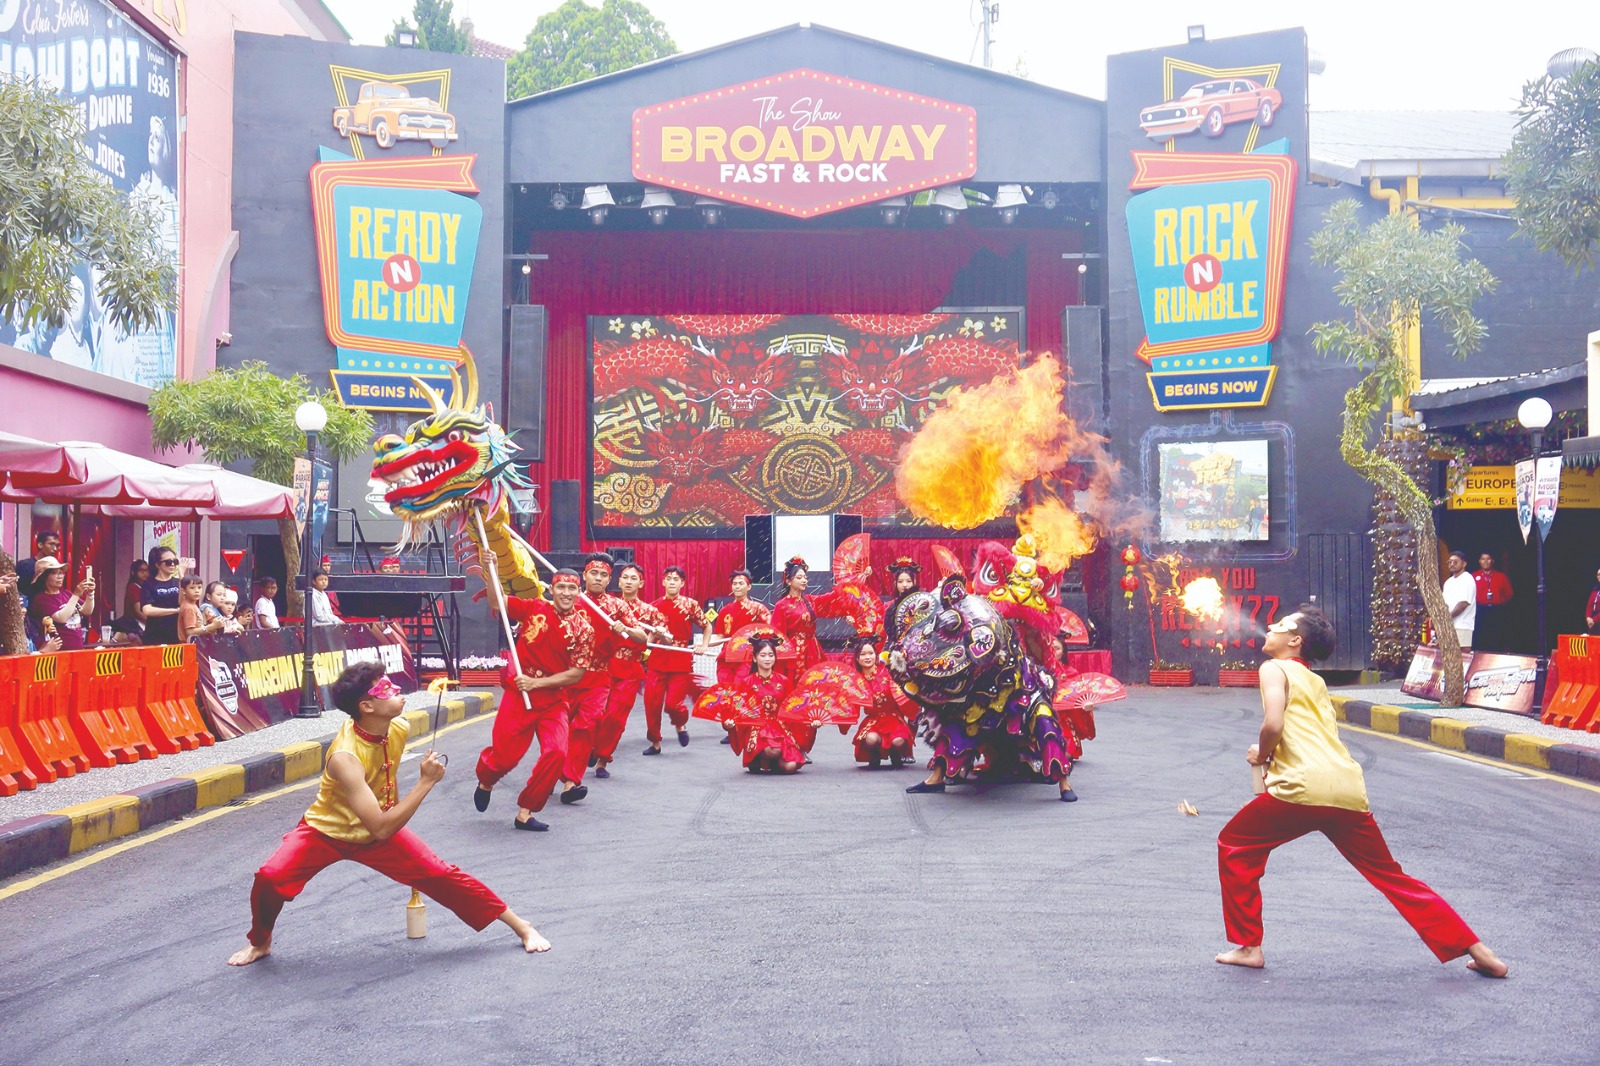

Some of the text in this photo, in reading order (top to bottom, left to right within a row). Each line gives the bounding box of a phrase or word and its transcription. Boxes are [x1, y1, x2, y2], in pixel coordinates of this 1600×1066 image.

[71, 37, 139, 93] BOAT
[147, 72, 170, 98] 1936
[89, 94, 132, 131] DUNNE
[753, 96, 842, 132] The Show
[96, 141, 125, 178] JONES
[661, 124, 946, 162] BROADWAY
[720, 162, 888, 183] FAST & ROCK
[349, 206, 461, 264] READY
[1154, 200, 1258, 267] ROCK
[390, 260, 413, 284] N
[1192, 260, 1214, 285] N
[352, 280, 455, 324] ACTION
[1154, 281, 1258, 324] RUMBLE
[350, 384, 445, 399] BEGINS NW
[1164, 381, 1258, 397] BEGINS NOW
[1466, 479, 1517, 489] EUROPE
[1220, 567, 1256, 589] YOU
[244, 655, 297, 699] MUSEUM
